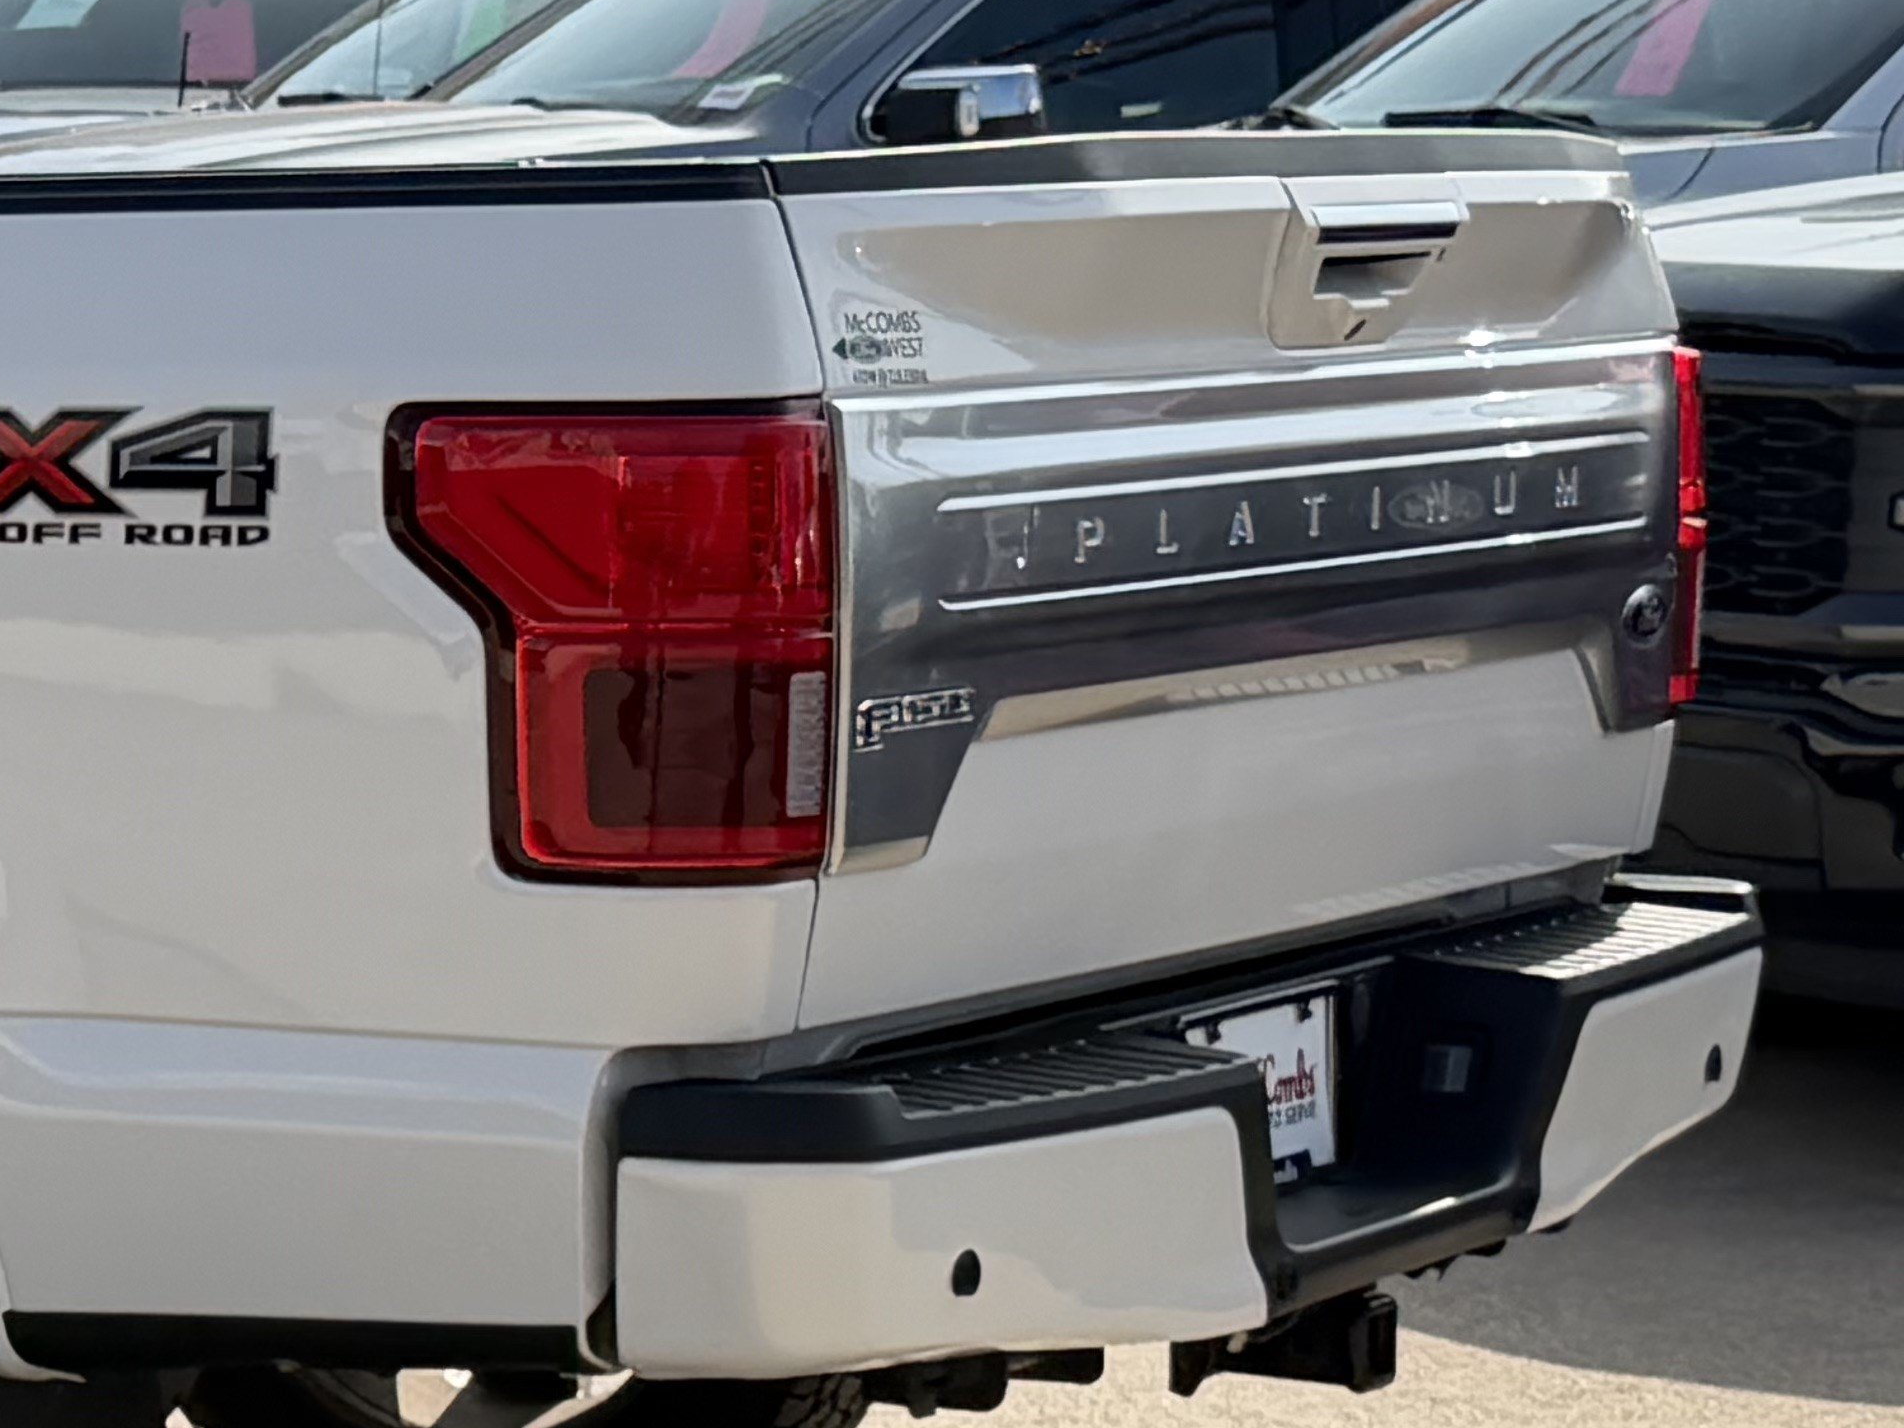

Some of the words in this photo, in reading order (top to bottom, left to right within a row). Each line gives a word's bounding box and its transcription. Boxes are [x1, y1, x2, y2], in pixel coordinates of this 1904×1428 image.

[843, 310, 922, 334] McCOMBS
[1073, 464, 1582, 564] PLATINUM
[123, 522, 271, 547] ROAD
